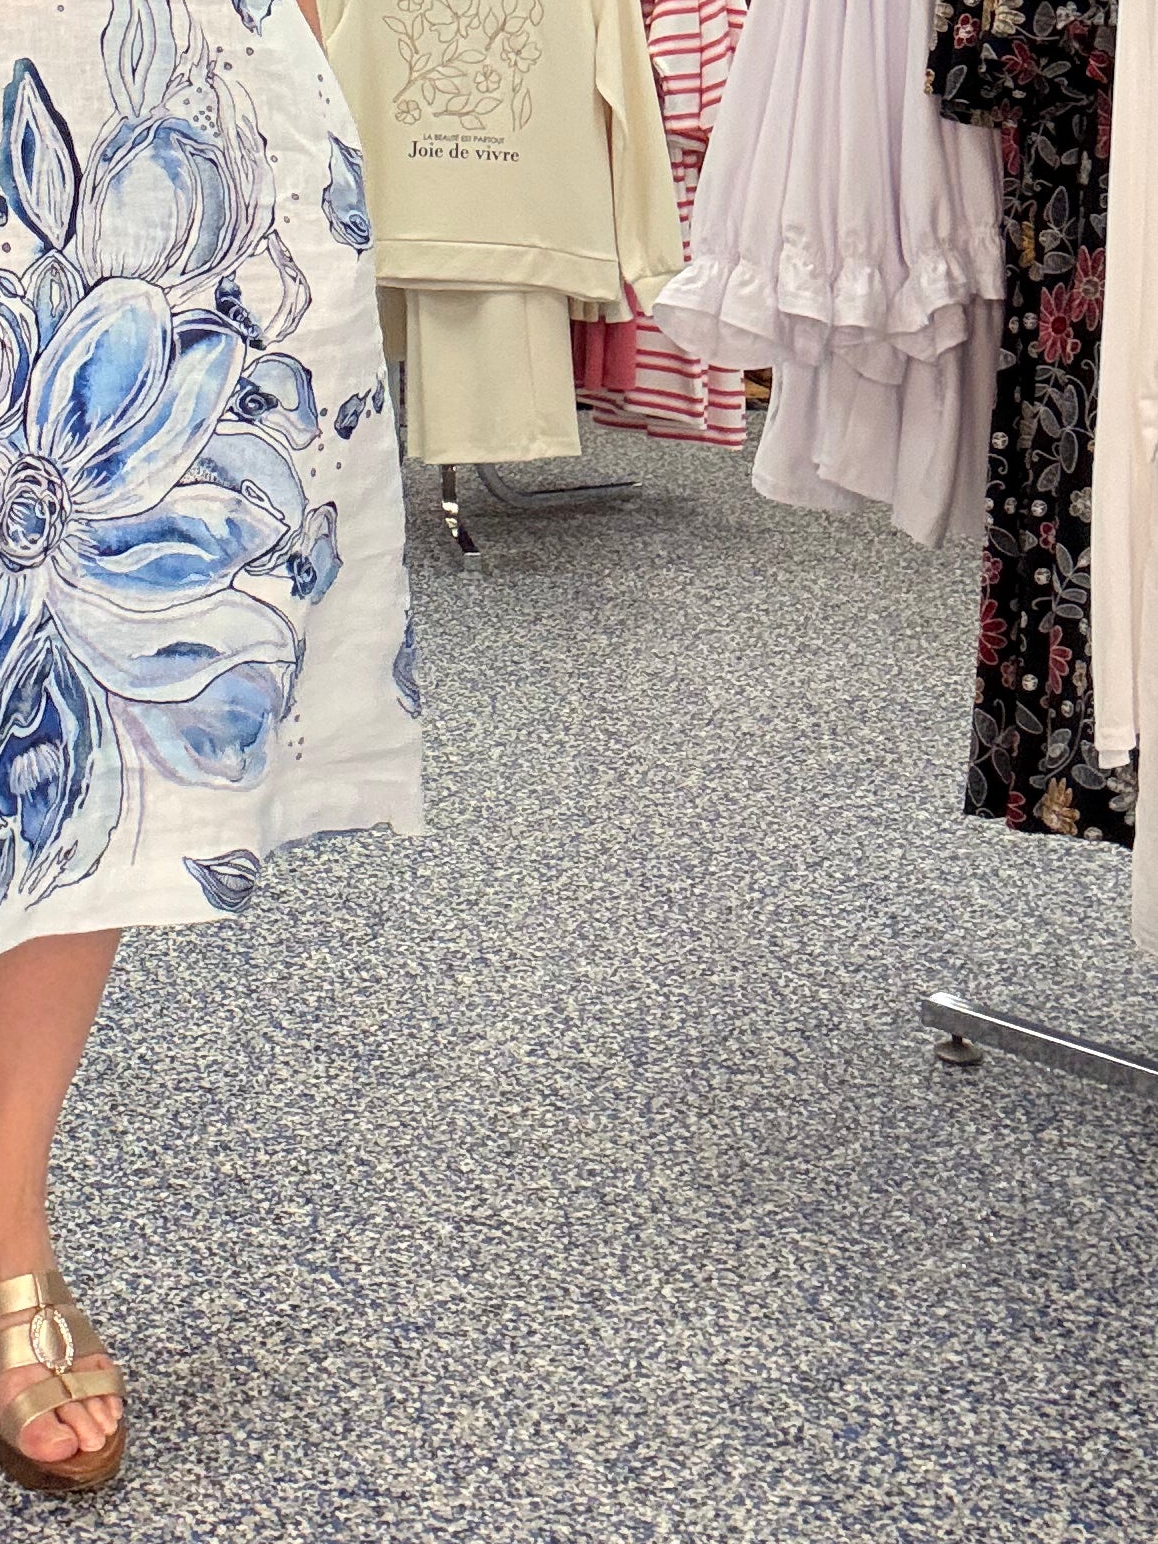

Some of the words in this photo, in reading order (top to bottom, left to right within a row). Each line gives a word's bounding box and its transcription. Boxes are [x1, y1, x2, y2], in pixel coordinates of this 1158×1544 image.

[408, 140, 443, 158] Joie
[449, 142, 469, 159] de
[475, 145, 520, 162] vivre
